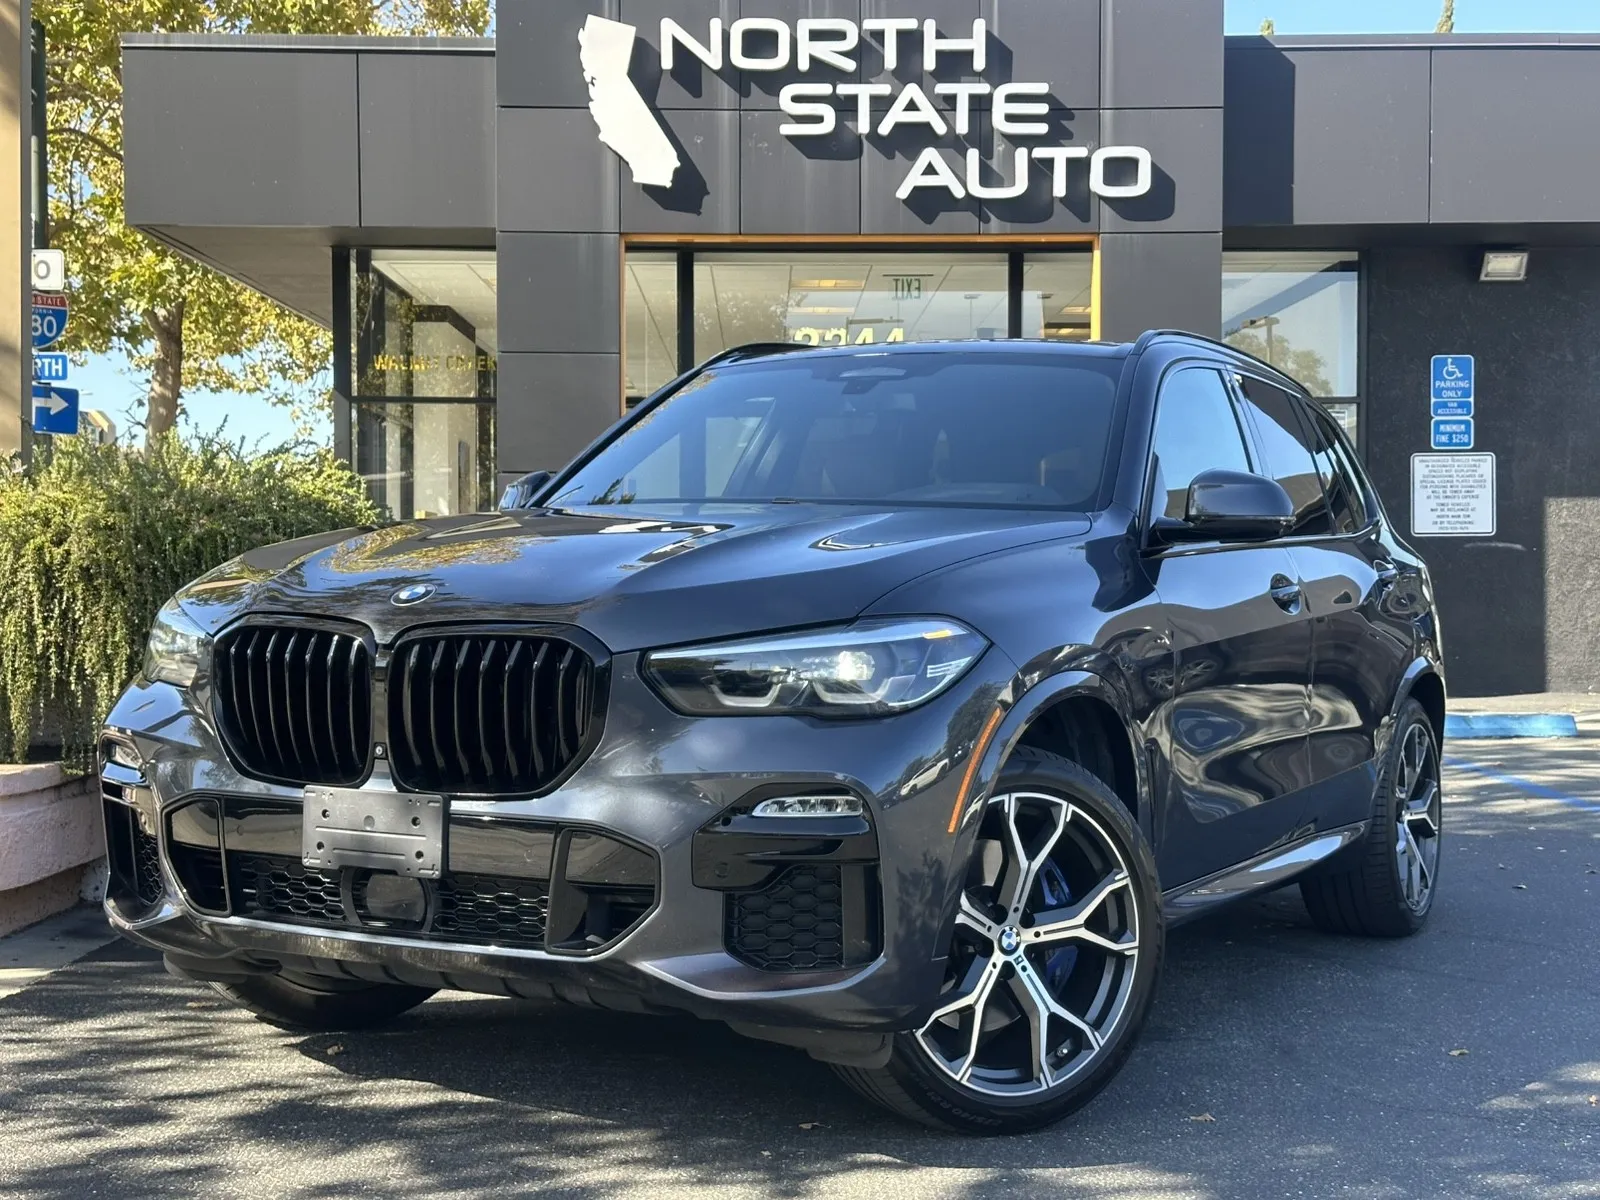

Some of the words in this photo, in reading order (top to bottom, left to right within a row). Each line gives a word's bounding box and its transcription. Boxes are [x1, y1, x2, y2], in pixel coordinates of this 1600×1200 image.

[660, 17, 986, 73] NORTH
[778, 82, 1050, 136] STATE
[895, 146, 1152, 200] AUTO
[32, 295, 61, 306] STATE
[1435, 380, 1470, 389] PARKING
[1441, 390, 1462, 398] ONLY
[1435, 433, 1450, 443] FINE
[1452, 433, 1469, 443] $250
